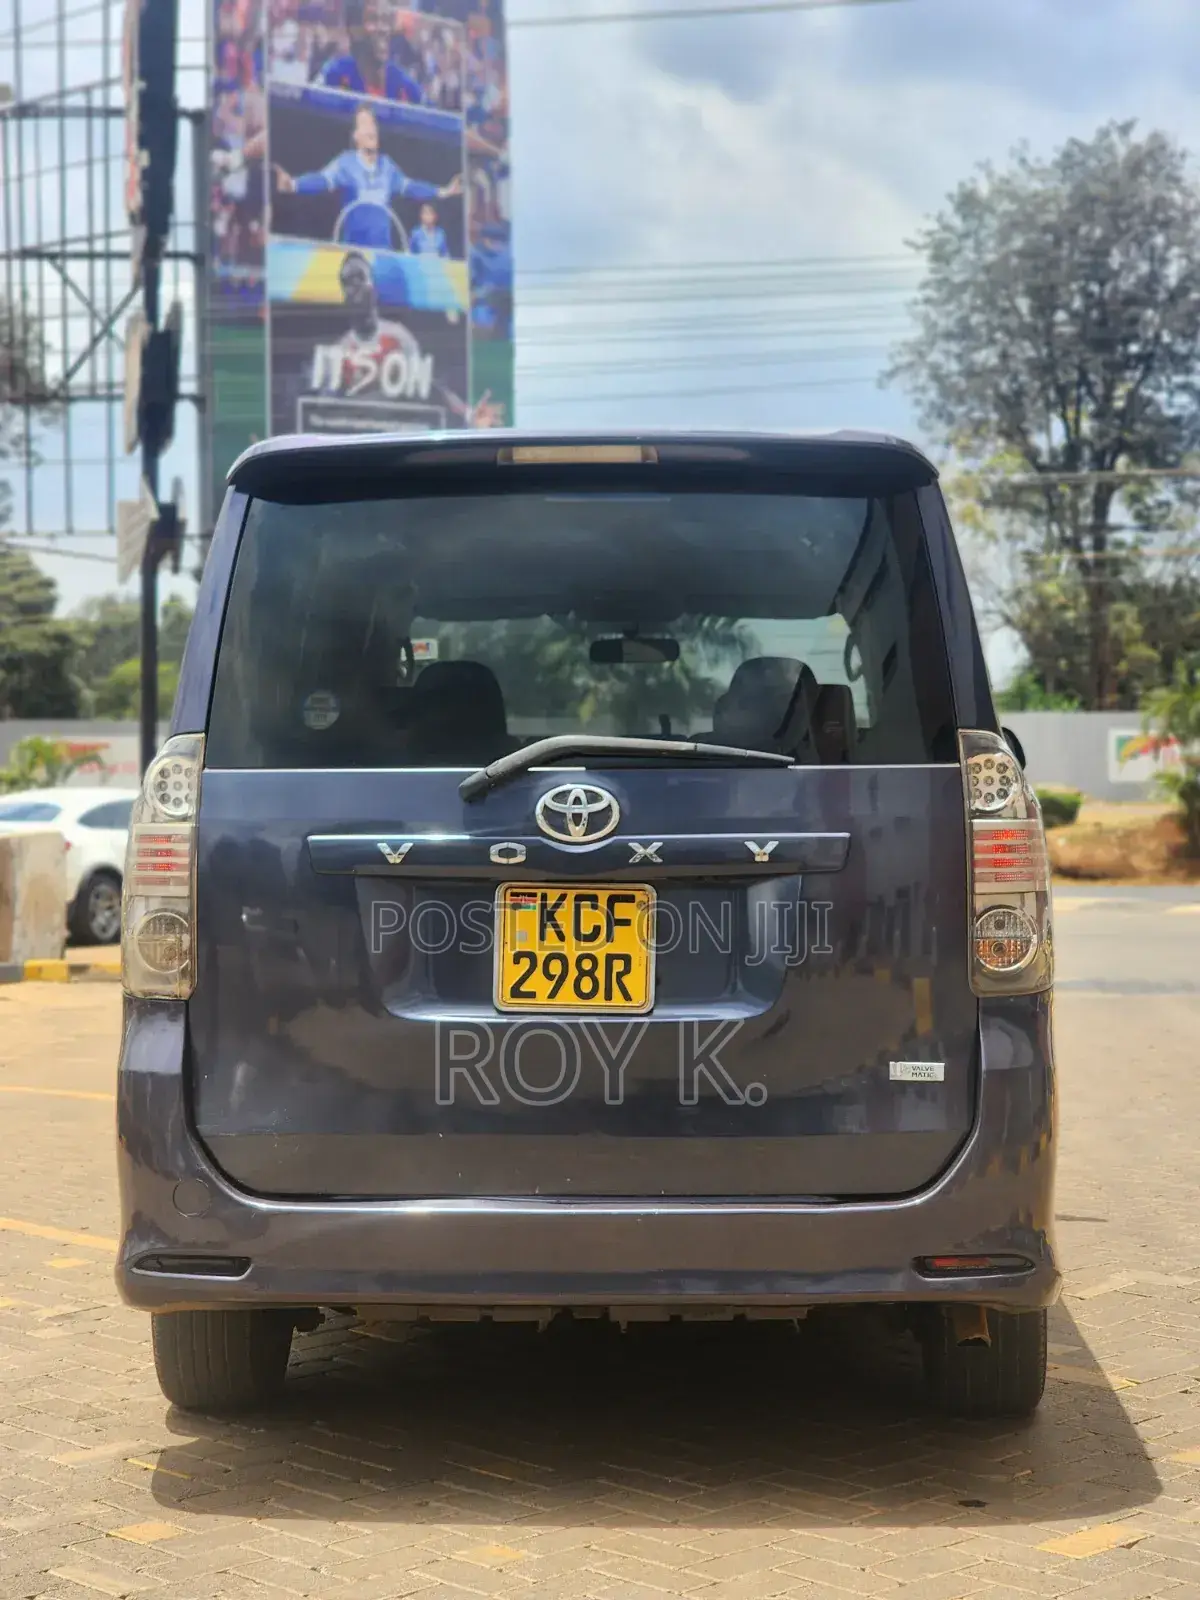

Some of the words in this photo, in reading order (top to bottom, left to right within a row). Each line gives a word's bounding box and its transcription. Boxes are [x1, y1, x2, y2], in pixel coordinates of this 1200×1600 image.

[377, 841, 779, 864] VOXY
[539, 892, 636, 943] KCF
[510, 951, 633, 1002] 298R
